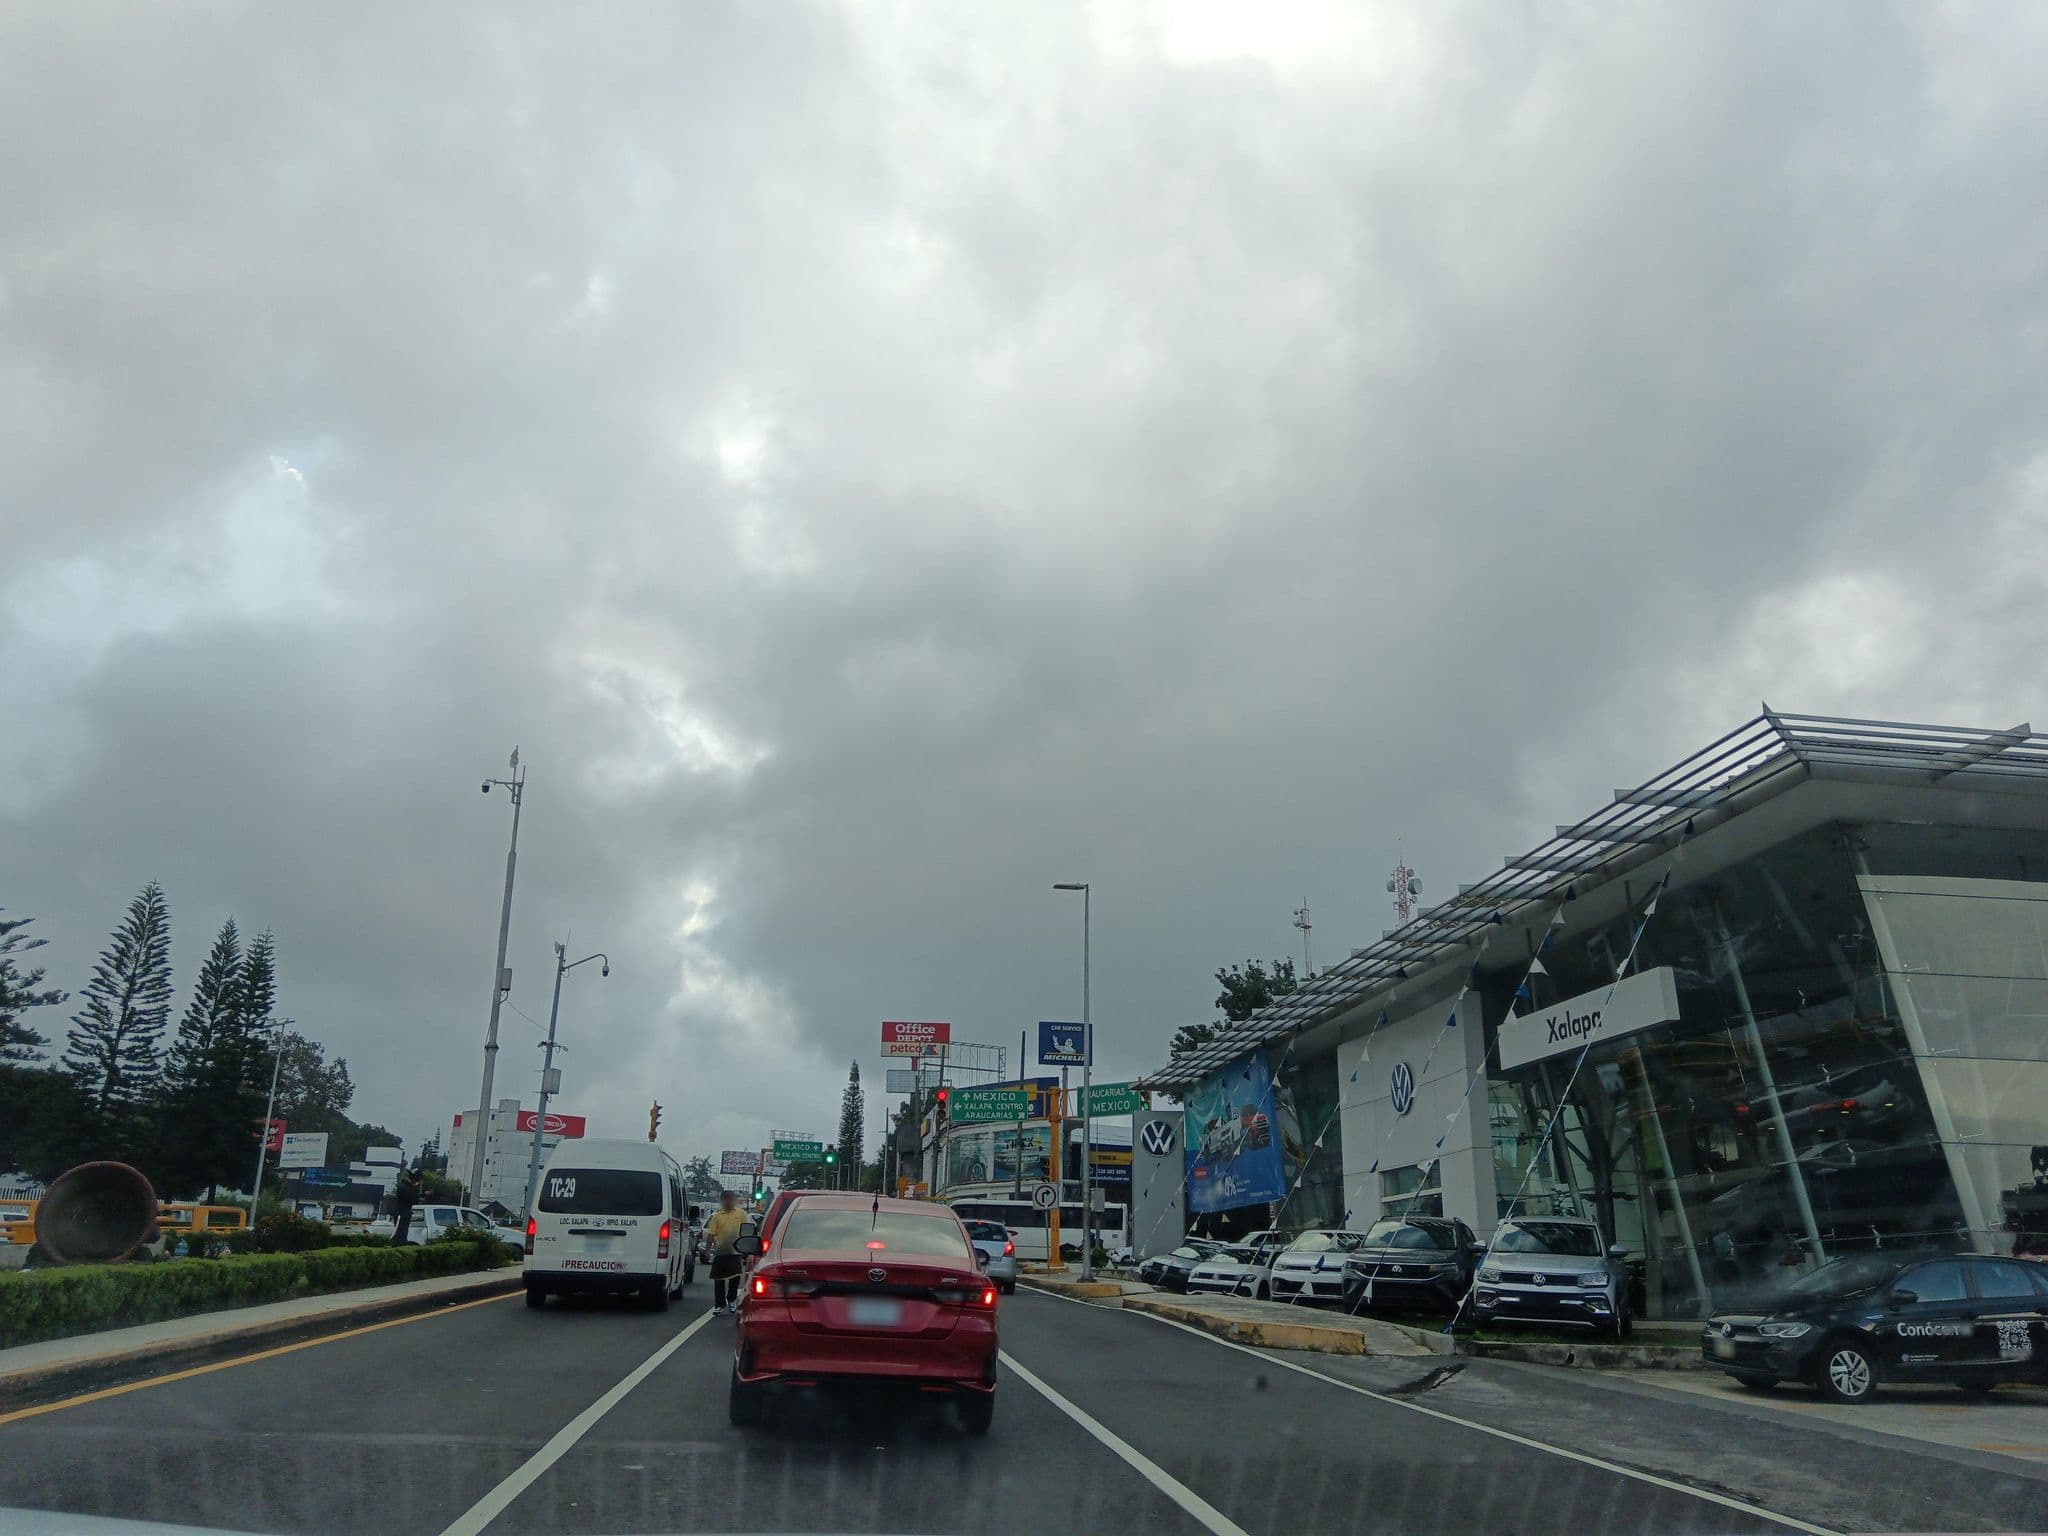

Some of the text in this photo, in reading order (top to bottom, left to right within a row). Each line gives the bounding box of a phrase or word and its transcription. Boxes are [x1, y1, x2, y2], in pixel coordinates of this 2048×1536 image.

[895, 1023, 936, 1034] Office
[1546, 1010, 1602, 1044] Xalapa
[897, 1034, 934, 1042] DEPOT
[890, 1044, 921, 1054] petco
[973, 1092, 1016, 1101] MEXICO
[963, 1102, 993, 1110] XALAPA
[1092, 1100, 1131, 1113] MEXICO
[964, 1111, 1014, 1120] ARAUCARIAS
[780, 1143, 810, 1152] MEXICO
[781, 1151, 801, 1159] XALAPA
[550, 1178, 576, 1198] TC-29
[571, 1218, 589, 1226] XALAPA
[620, 1219, 638, 1227] XALAPA
